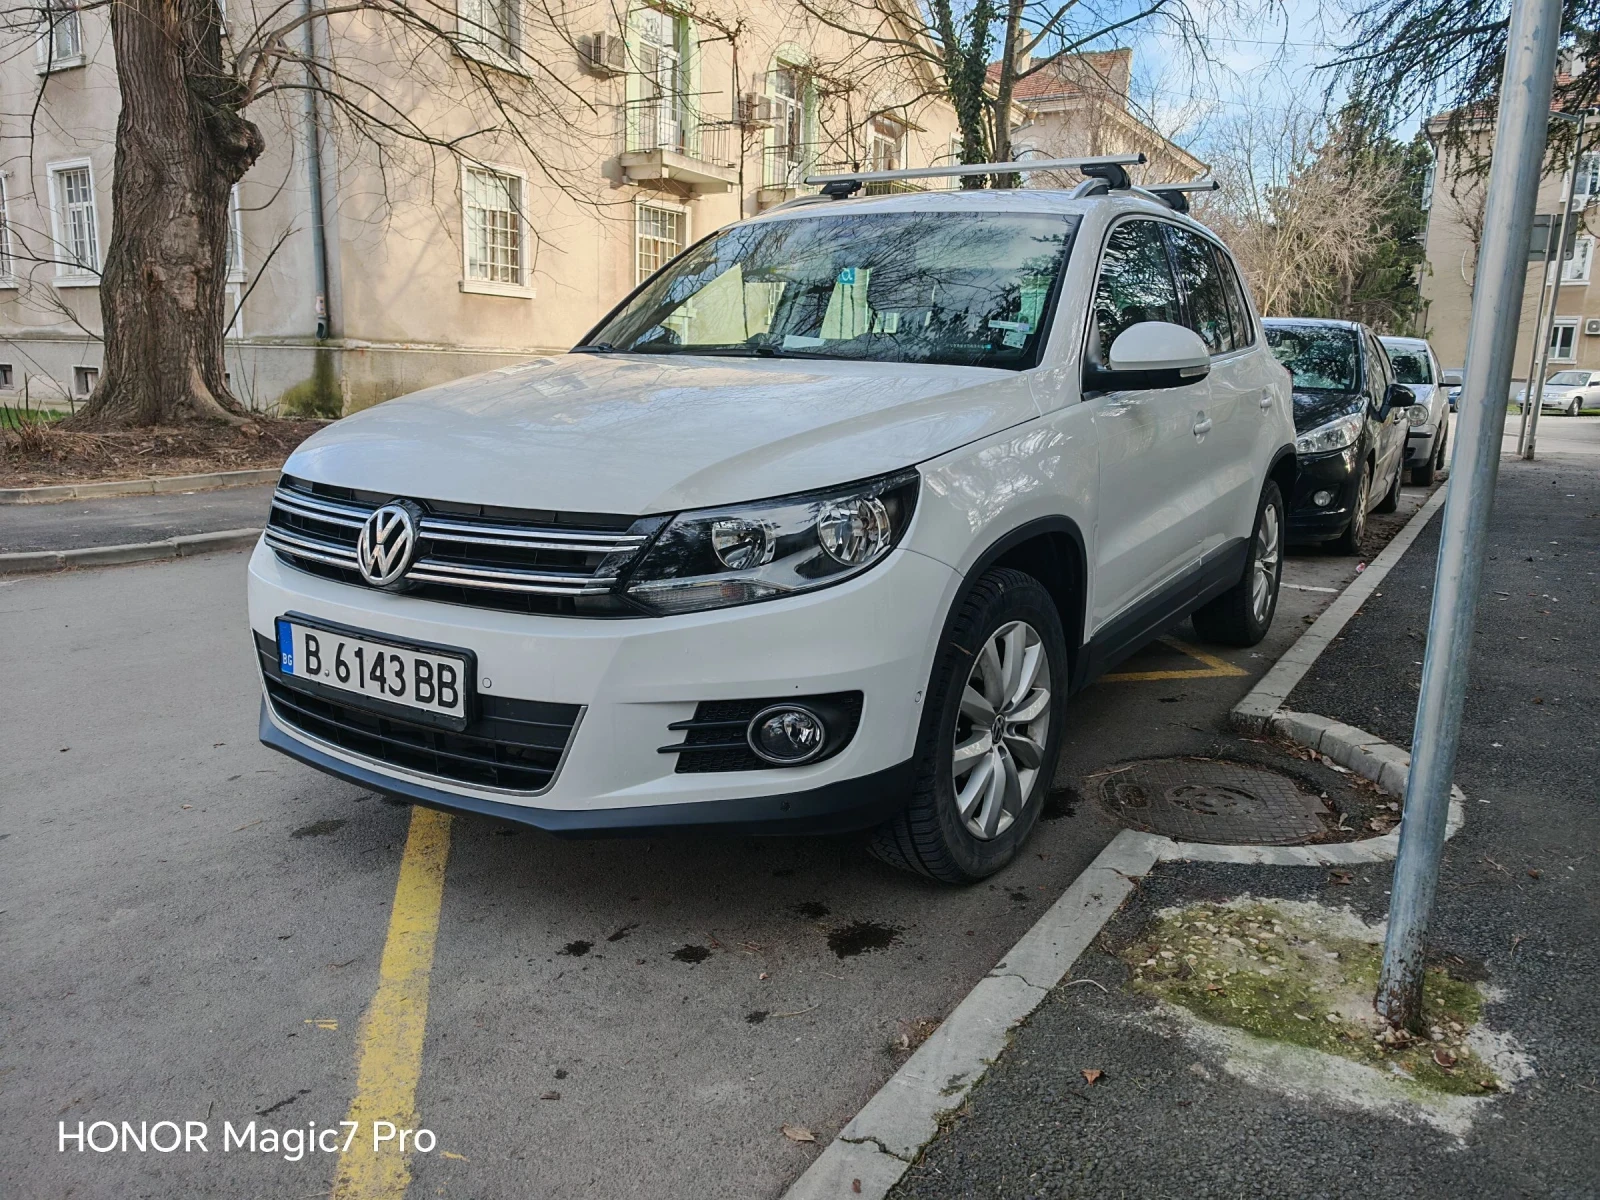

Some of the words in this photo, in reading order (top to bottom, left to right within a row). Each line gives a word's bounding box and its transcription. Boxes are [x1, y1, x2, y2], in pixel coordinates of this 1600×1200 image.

[282, 652, 293, 666] BG
[334, 642, 407, 697] 6143
[414, 658, 459, 709] BB
